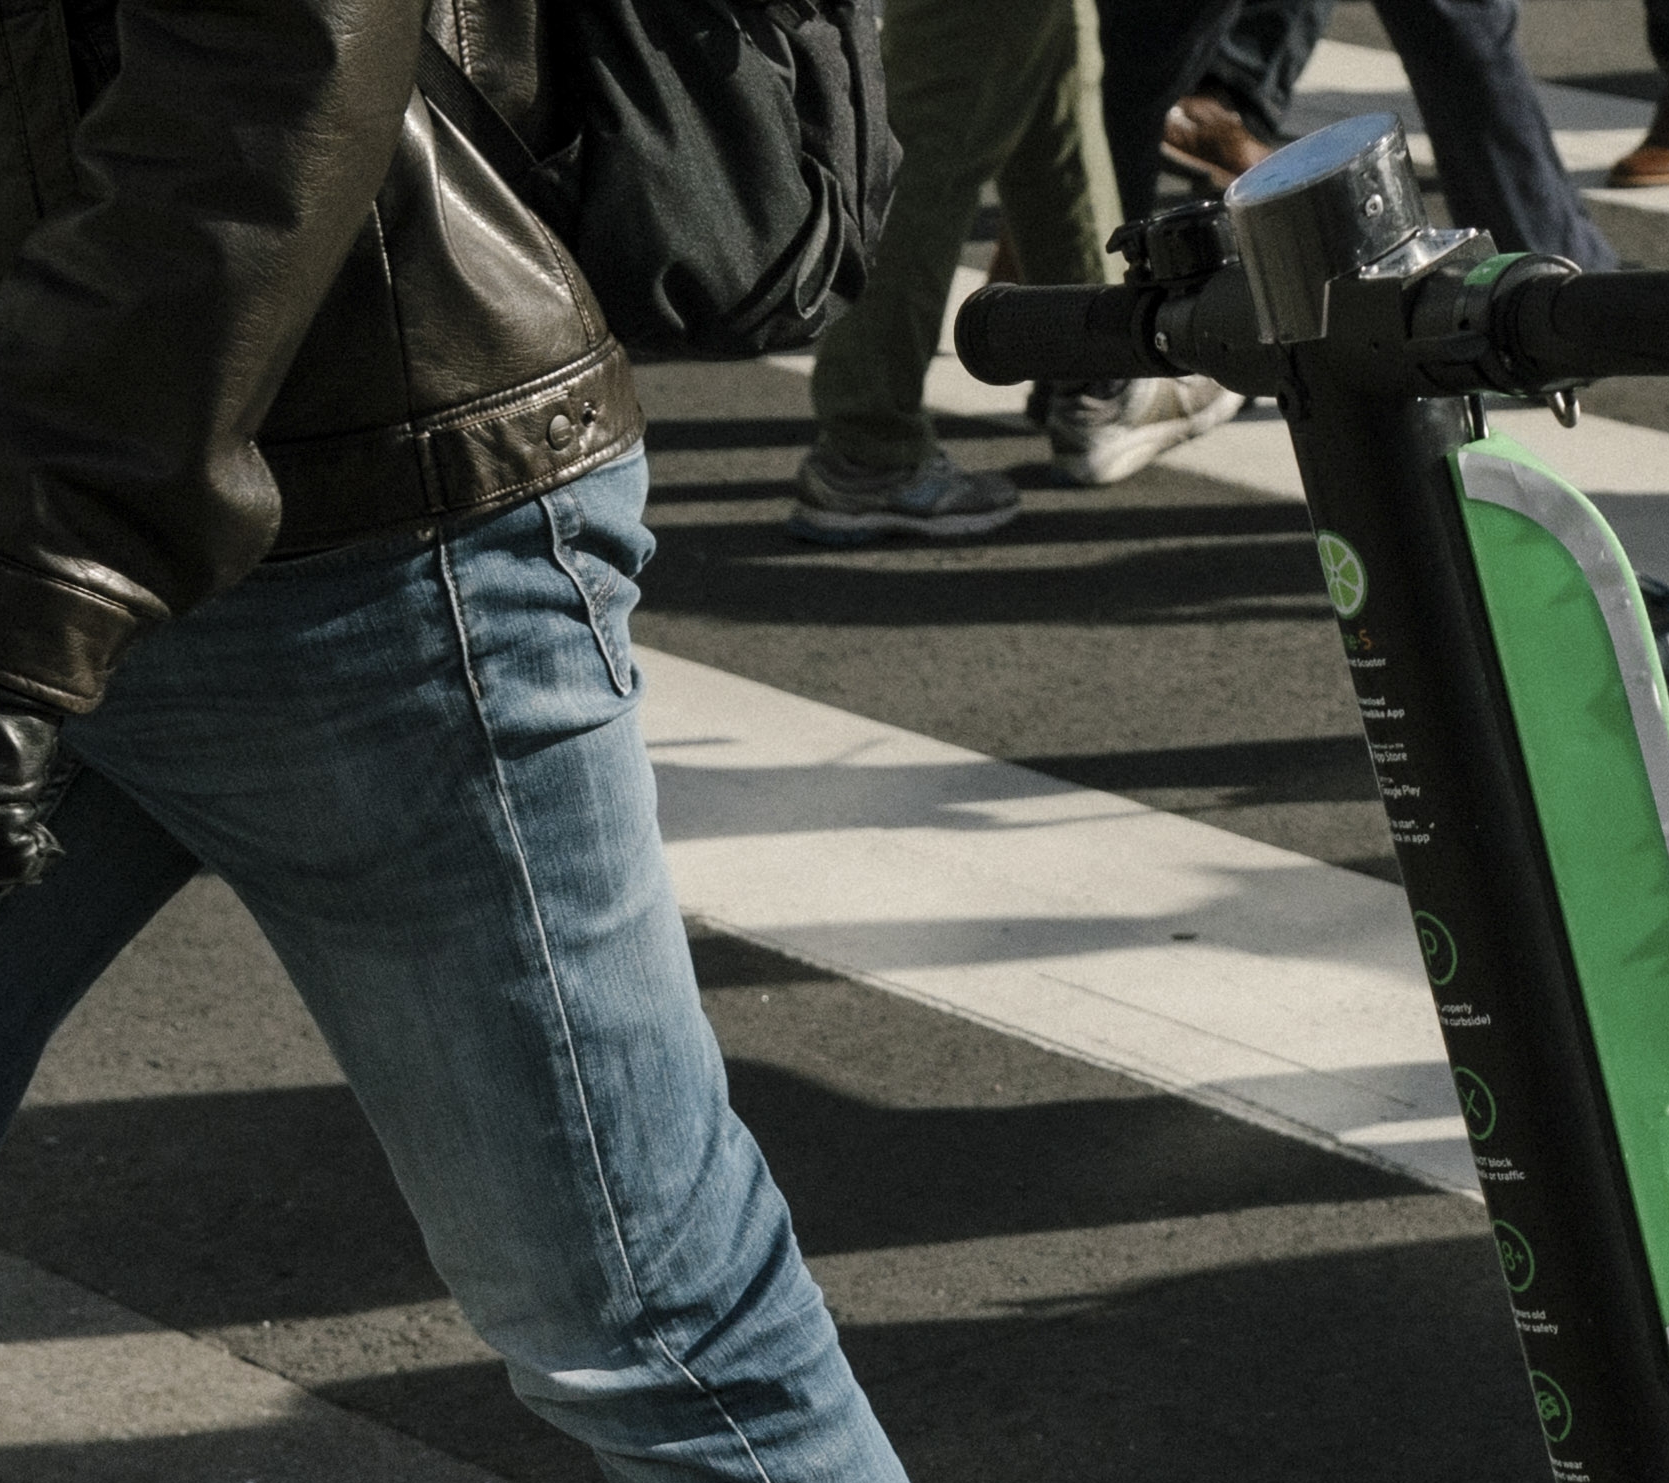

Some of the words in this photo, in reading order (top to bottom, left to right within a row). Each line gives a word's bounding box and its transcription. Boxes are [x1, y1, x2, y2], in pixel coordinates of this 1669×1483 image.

[1386, 708, 1406, 720] App
[1385, 751, 1408, 762] Store
[1401, 784, 1421, 797] Play
[1411, 833, 1431, 845] app
[1488, 1156, 1514, 1169] block
[1497, 1169, 1527, 1182] traffic
[1531, 1323, 1559, 1336] safety
